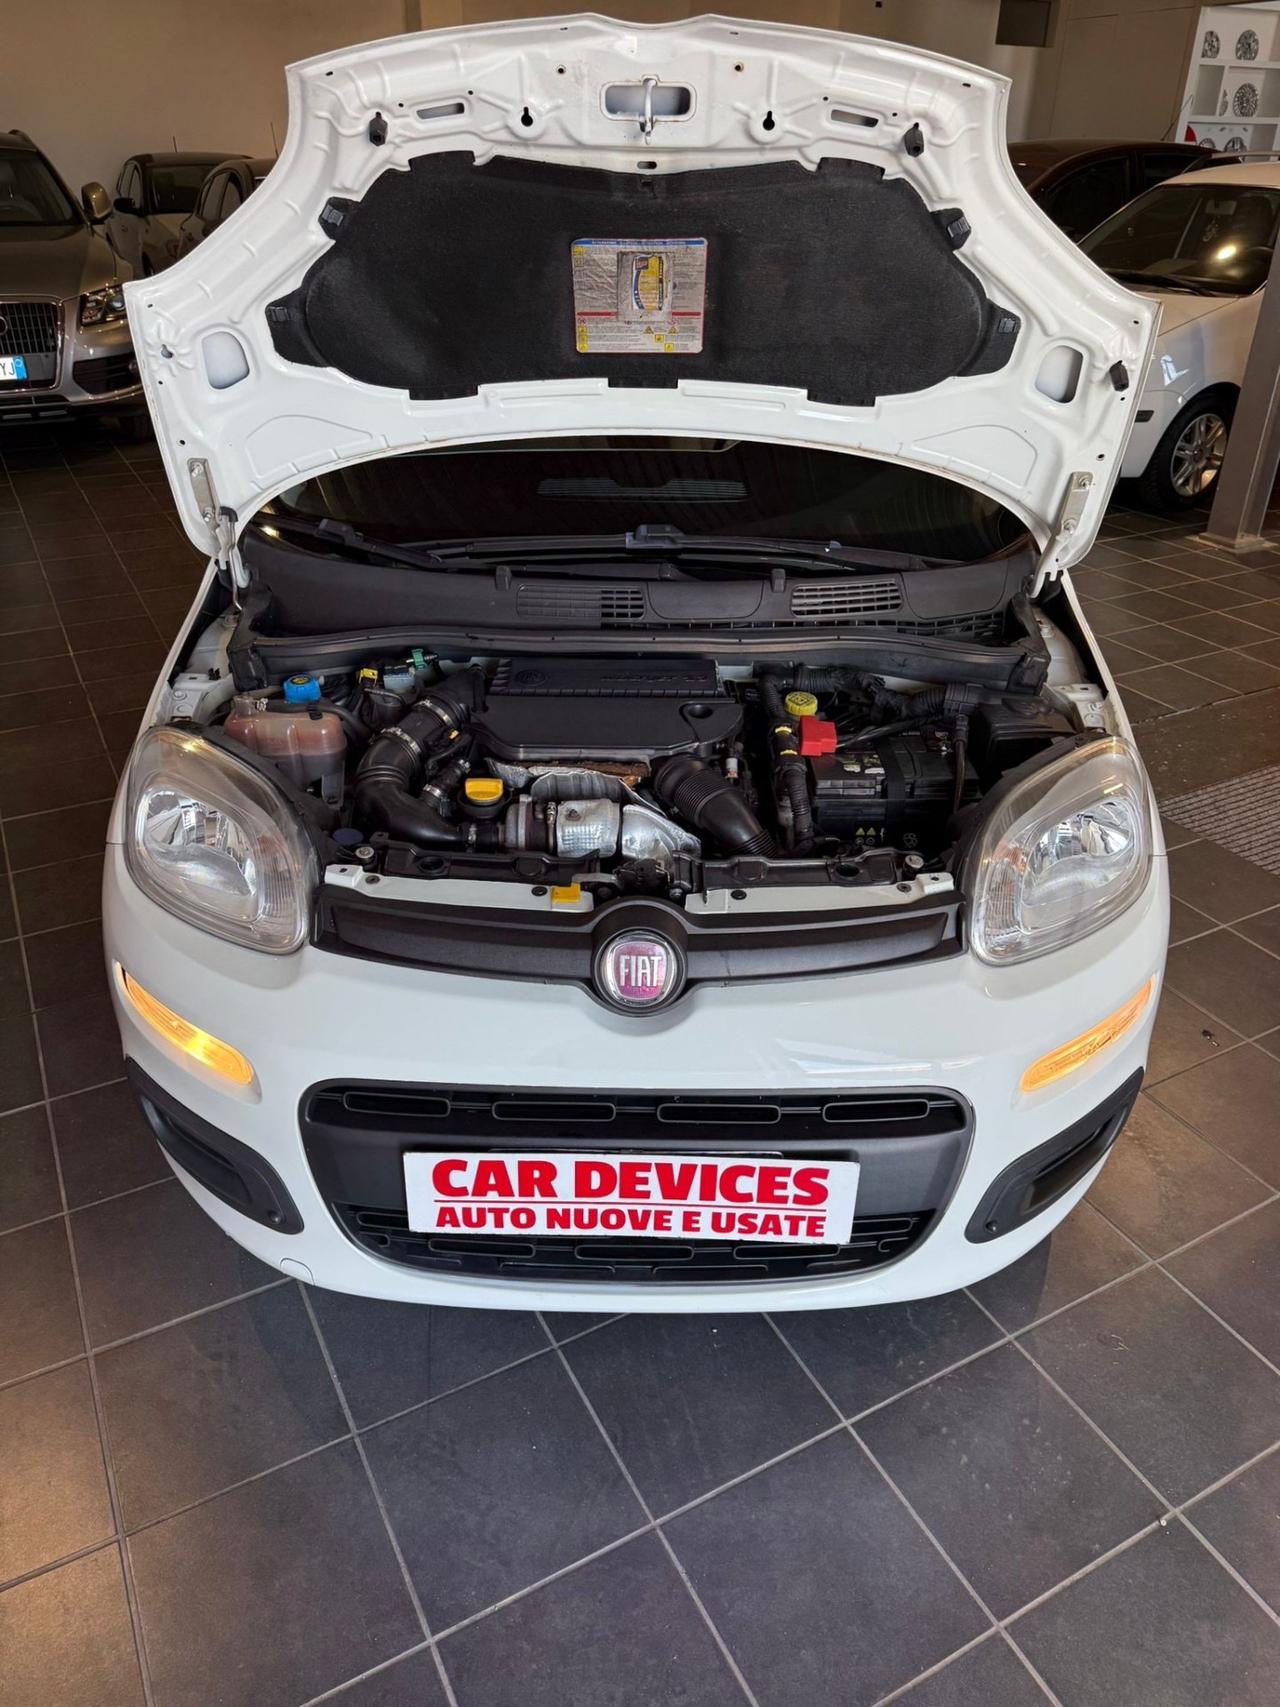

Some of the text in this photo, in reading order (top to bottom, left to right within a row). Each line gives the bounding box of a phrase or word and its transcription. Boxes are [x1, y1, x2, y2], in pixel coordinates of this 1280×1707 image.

[620, 955, 662, 987] FIAT
[432, 1159, 829, 1206] CAR DEVICES
[436, 1207, 825, 1237] AUTO NUOVE E USATE
